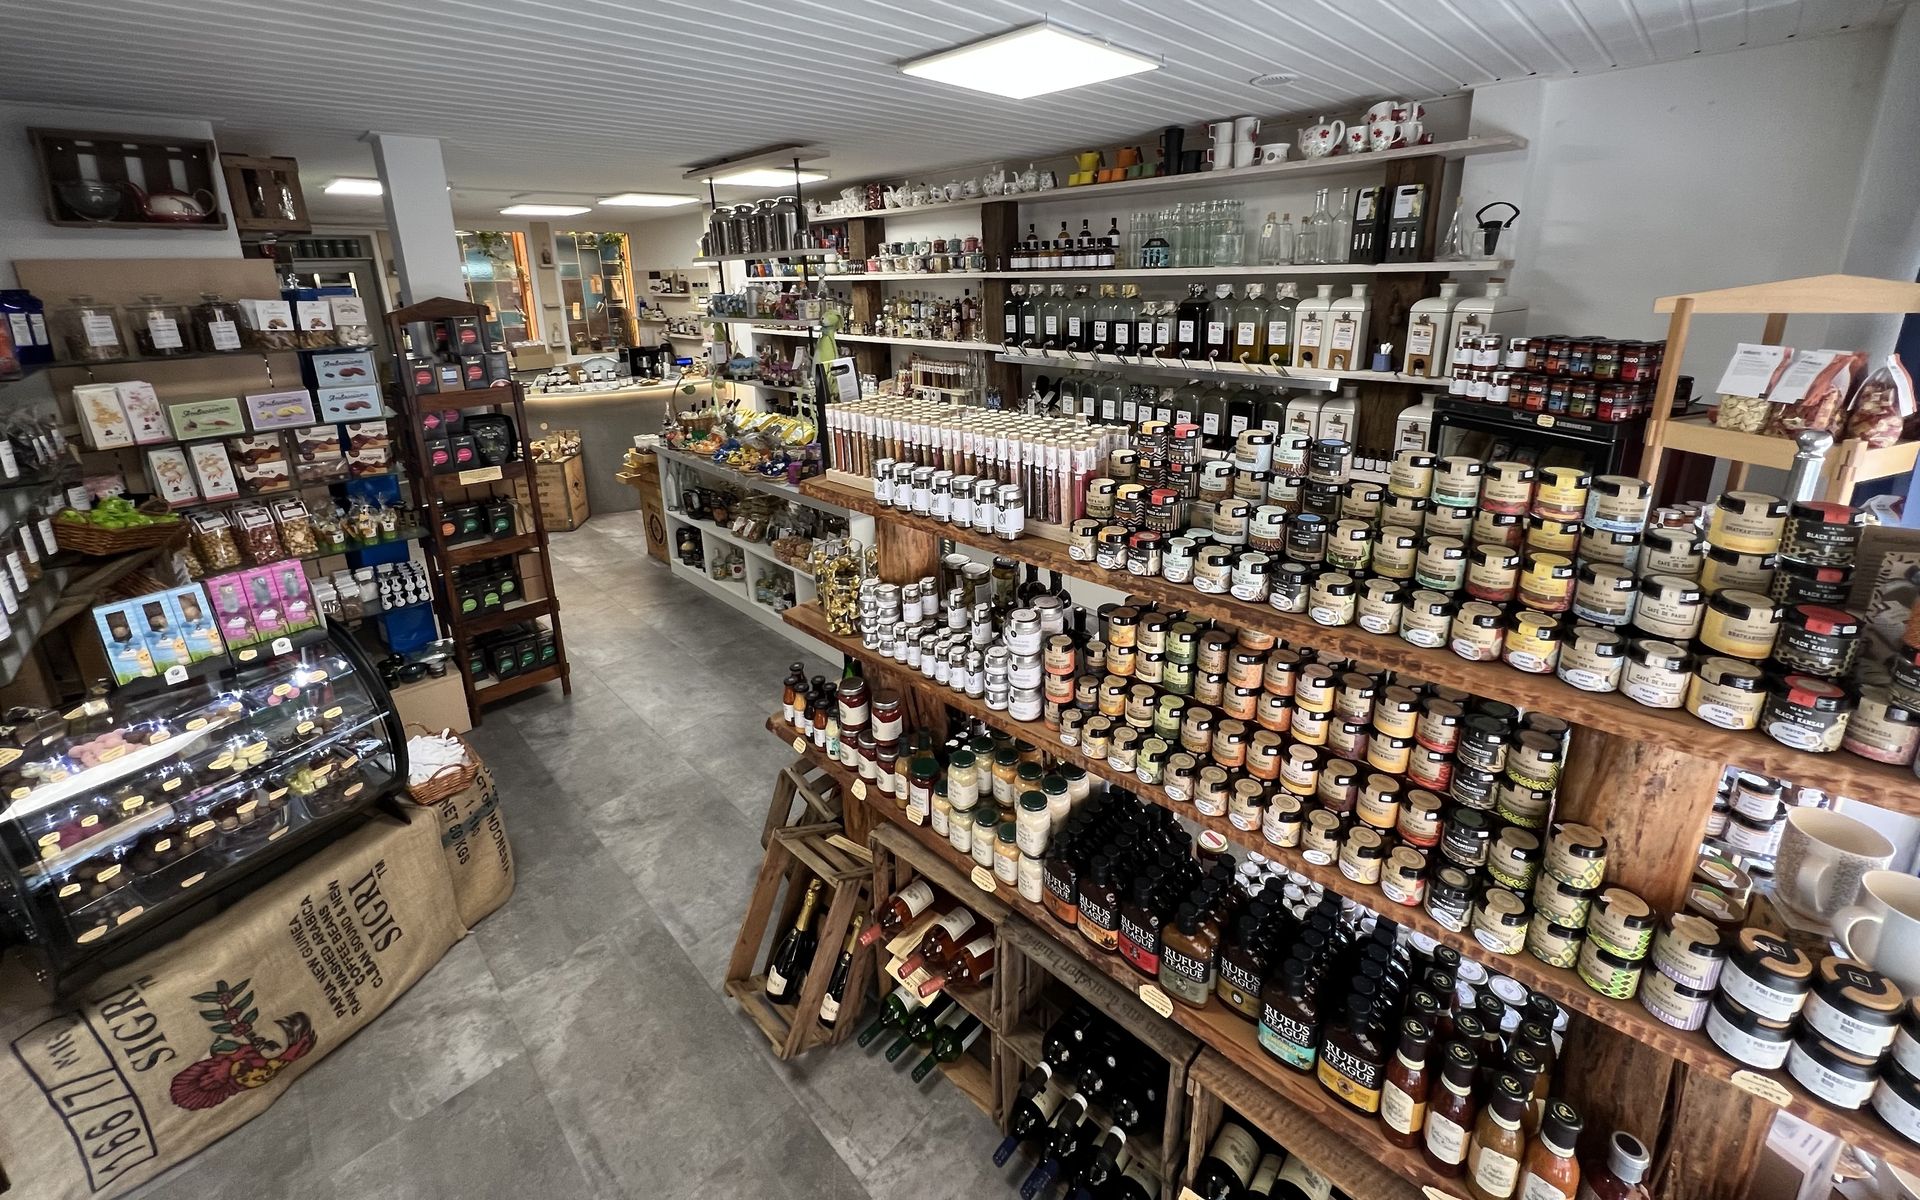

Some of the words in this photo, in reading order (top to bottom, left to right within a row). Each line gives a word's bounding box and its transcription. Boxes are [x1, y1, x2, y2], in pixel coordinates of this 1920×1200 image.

[258, 468, 275, 476] Dark
[1806, 531, 1829, 540] BLACK
[1788, 636, 1809, 648] BLACK
[1811, 644, 1839, 655] KANSAS
[1636, 673, 1650, 684] CAFÉ
[1774, 708, 1795, 721] BLACK
[1796, 717, 1825, 729] KANSAS
[438, 798, 459, 823] NET
[453, 837, 471, 866] KGS
[486, 809, 514, 878] INDONESIA
[374, 858, 388, 879] TM
[327, 879, 344, 909] NEW
[348, 868, 404, 952] SIGRI
[1080, 892, 1111, 920] RUFUS
[301, 894, 327, 947] ARABICA
[318, 904, 343, 945] BEANS
[336, 906, 347, 918] &
[1080, 901, 1110, 926] TEAGUE
[1121, 914, 1155, 943] RUFUS
[288, 914, 312, 959] GUINEA
[340, 915, 365, 952] SOUND
[1121, 923, 1154, 949] TEAGUE
[307, 957, 328, 984] NEW
[320, 944, 351, 987] WASHED
[336, 941, 366, 987] COFFEE
[358, 949, 384, 989] CLEAN
[1164, 946, 1205, 972] RUFUS
[1164, 954, 1204, 980] TEAGUE
[1221, 956, 1261, 987] RUFUS
[1221, 965, 1260, 993] TEAGUE
[324, 980, 348, 1019] PAPUA
[342, 984, 362, 1017] RAW
[91, 984, 178, 1073] SIGRI
[1264, 1003, 1310, 1036] RUFUS
[1264, 1011, 1309, 1044] TEAGUE
[1325, 1048, 1374, 1085] TEAGUE
[1326, 1039, 1376, 1076] RUFUS
[84, 1109, 147, 1174] 166
